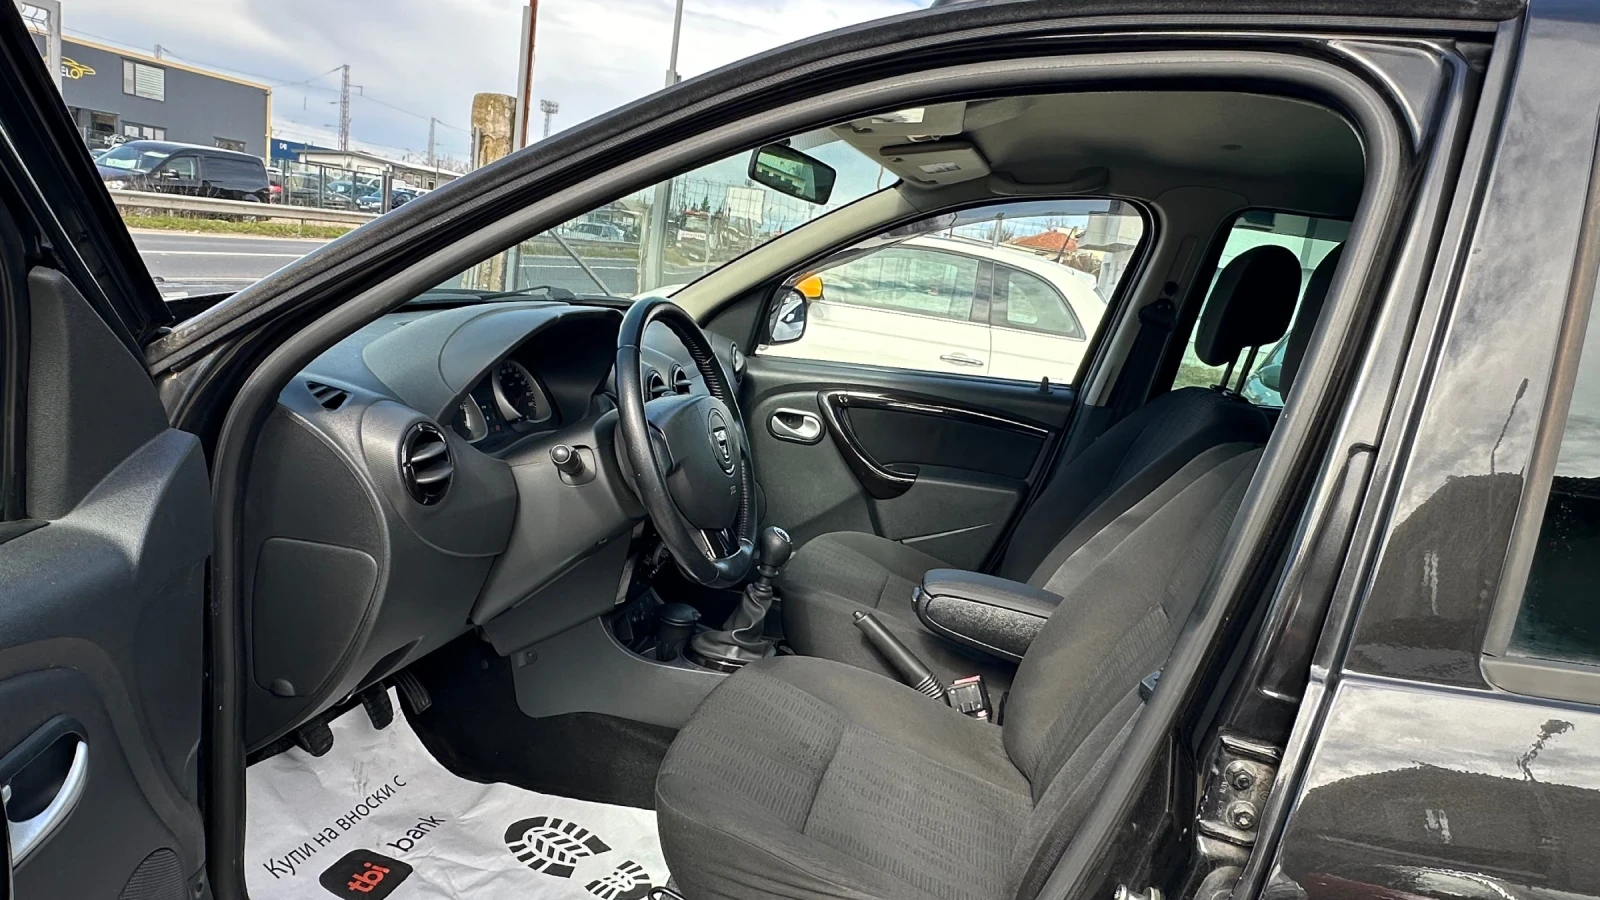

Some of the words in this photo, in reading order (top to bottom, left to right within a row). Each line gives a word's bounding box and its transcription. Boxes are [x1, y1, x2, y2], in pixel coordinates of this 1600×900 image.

[262, 842, 317, 879] Купи
[313, 827, 340, 847] на
[336, 783, 396, 831] вноски
[393, 774, 407, 787] с
[347, 861, 391, 893] tbi
[386, 815, 446, 853] bank
